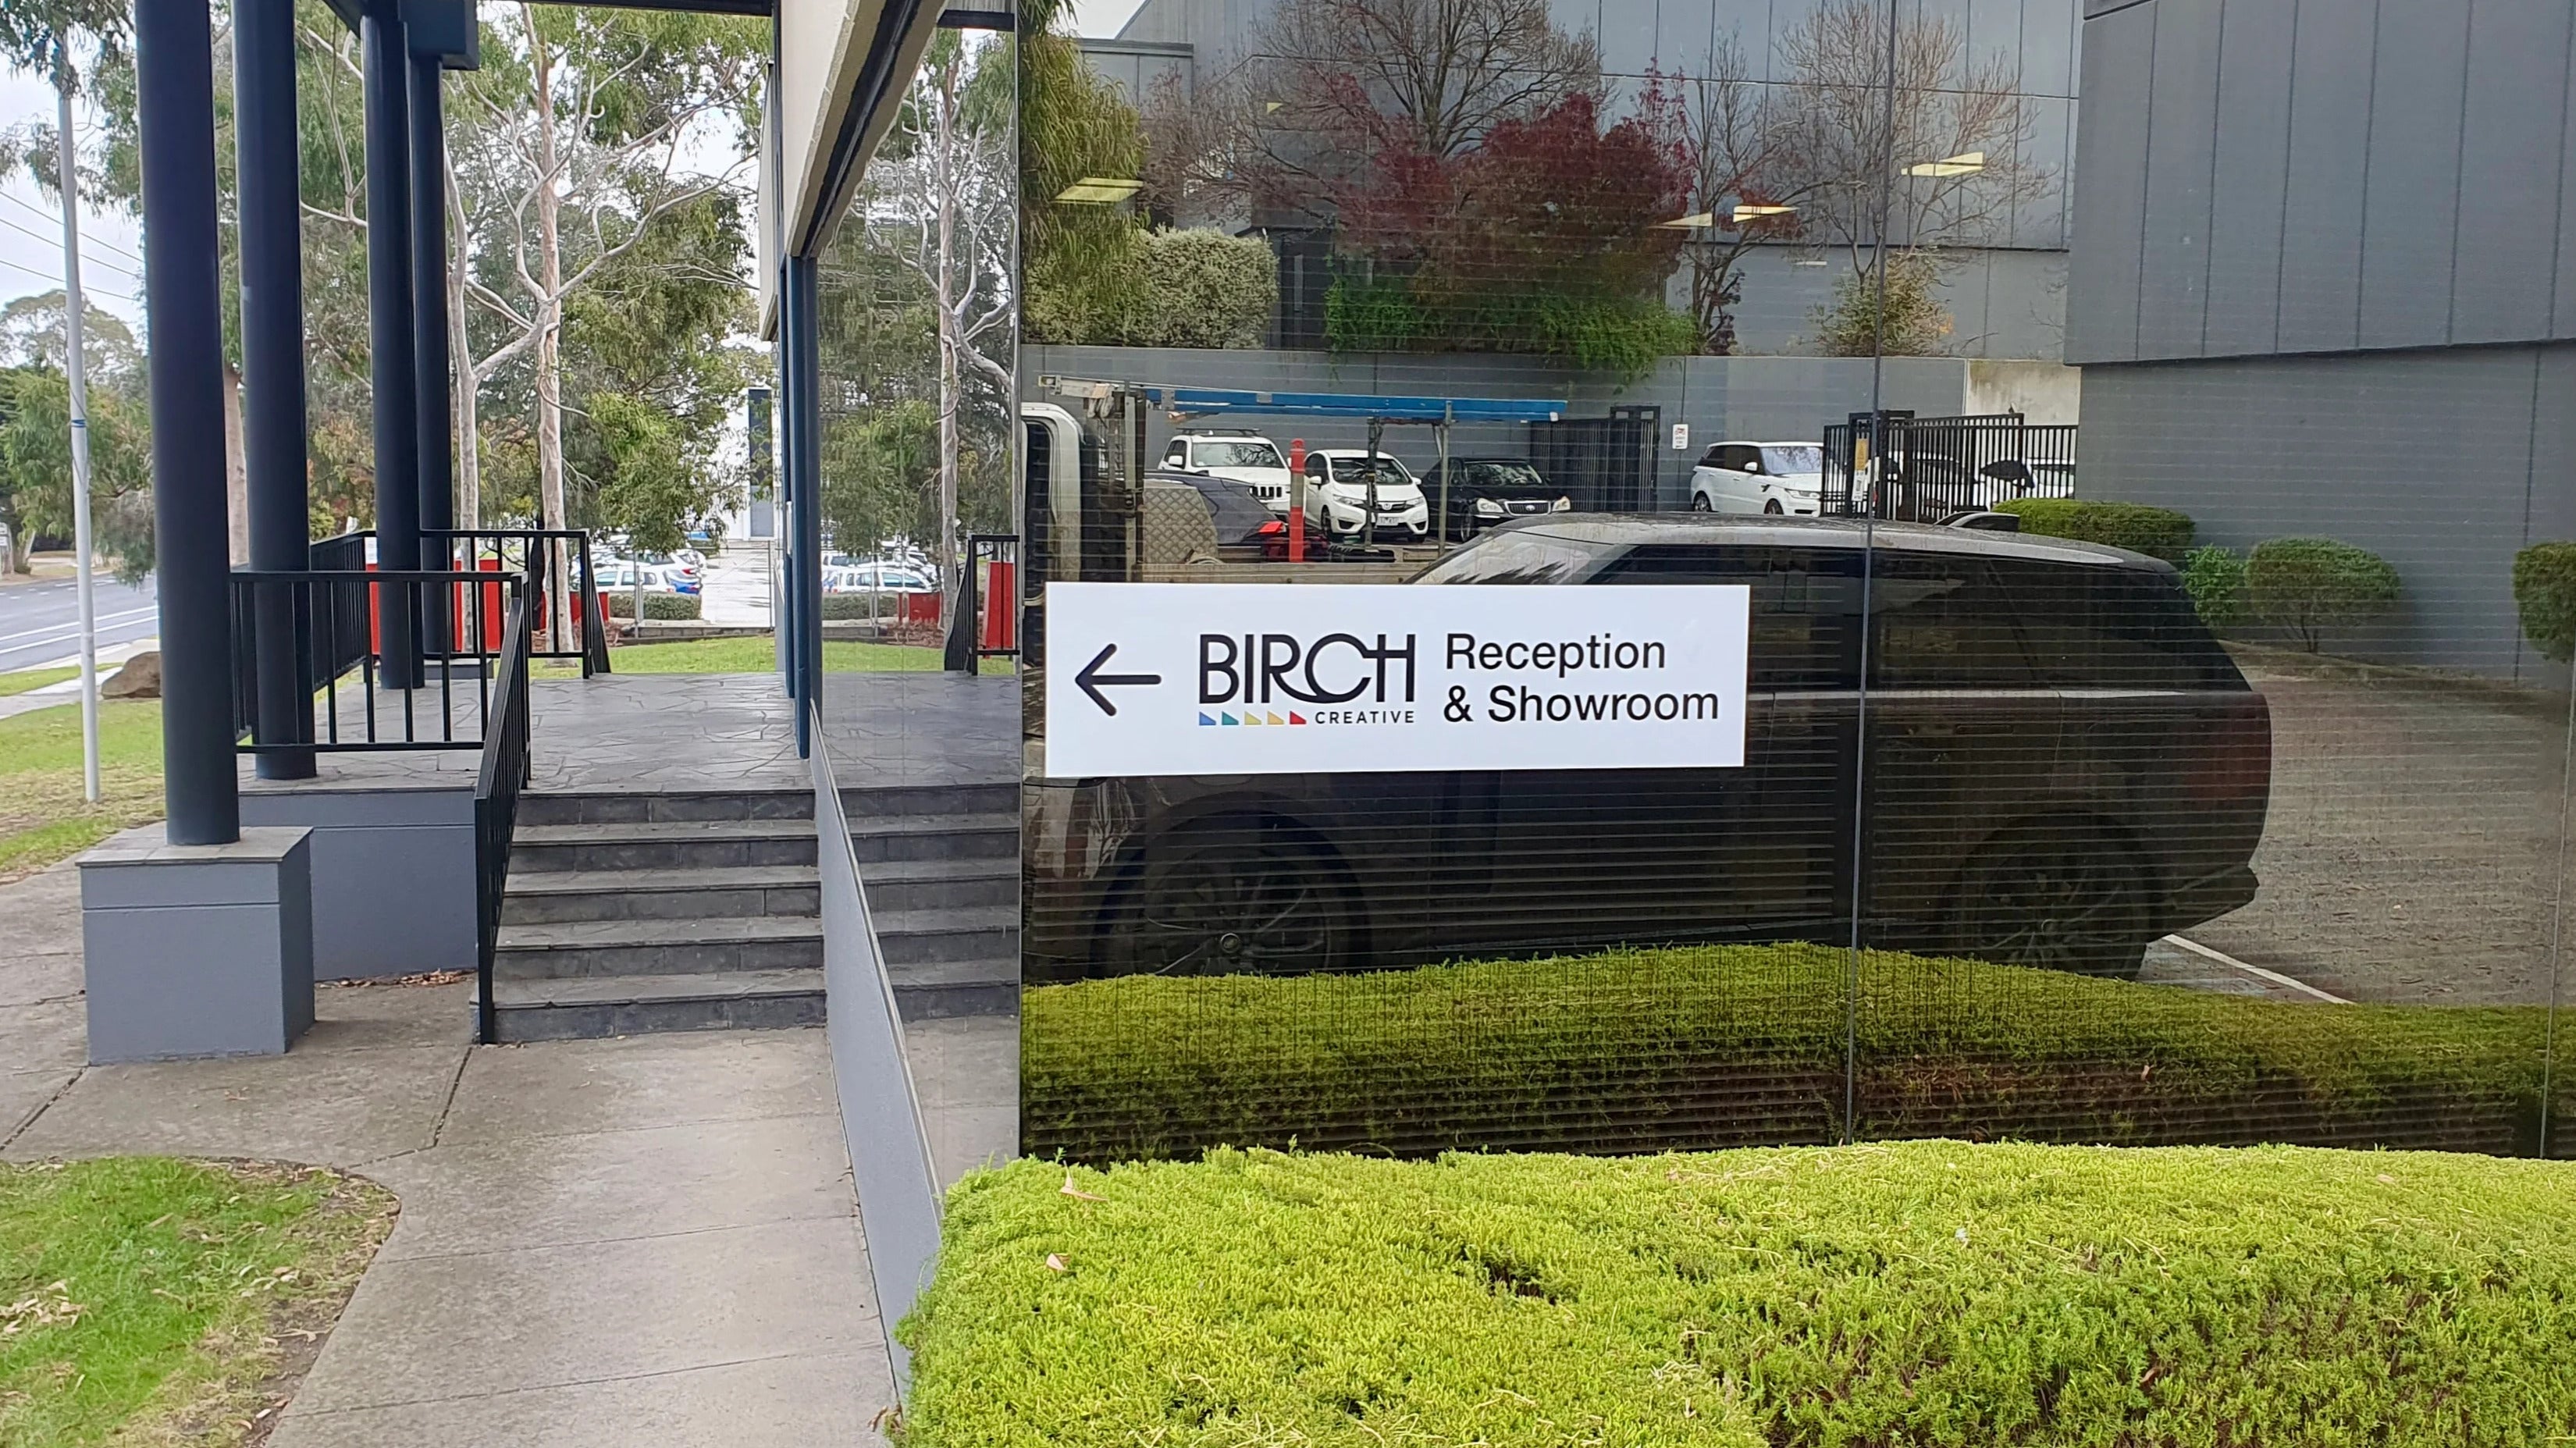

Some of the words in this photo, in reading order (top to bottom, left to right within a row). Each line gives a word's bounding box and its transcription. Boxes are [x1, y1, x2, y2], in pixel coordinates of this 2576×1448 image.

[1199, 632, 1416, 704] BIRCH
[1446, 633, 1665, 679] Reception
[1315, 710, 1415, 725] CREATIVE
[1443, 685, 1475, 723] &
[1488, 685, 1718, 723] Showroom
